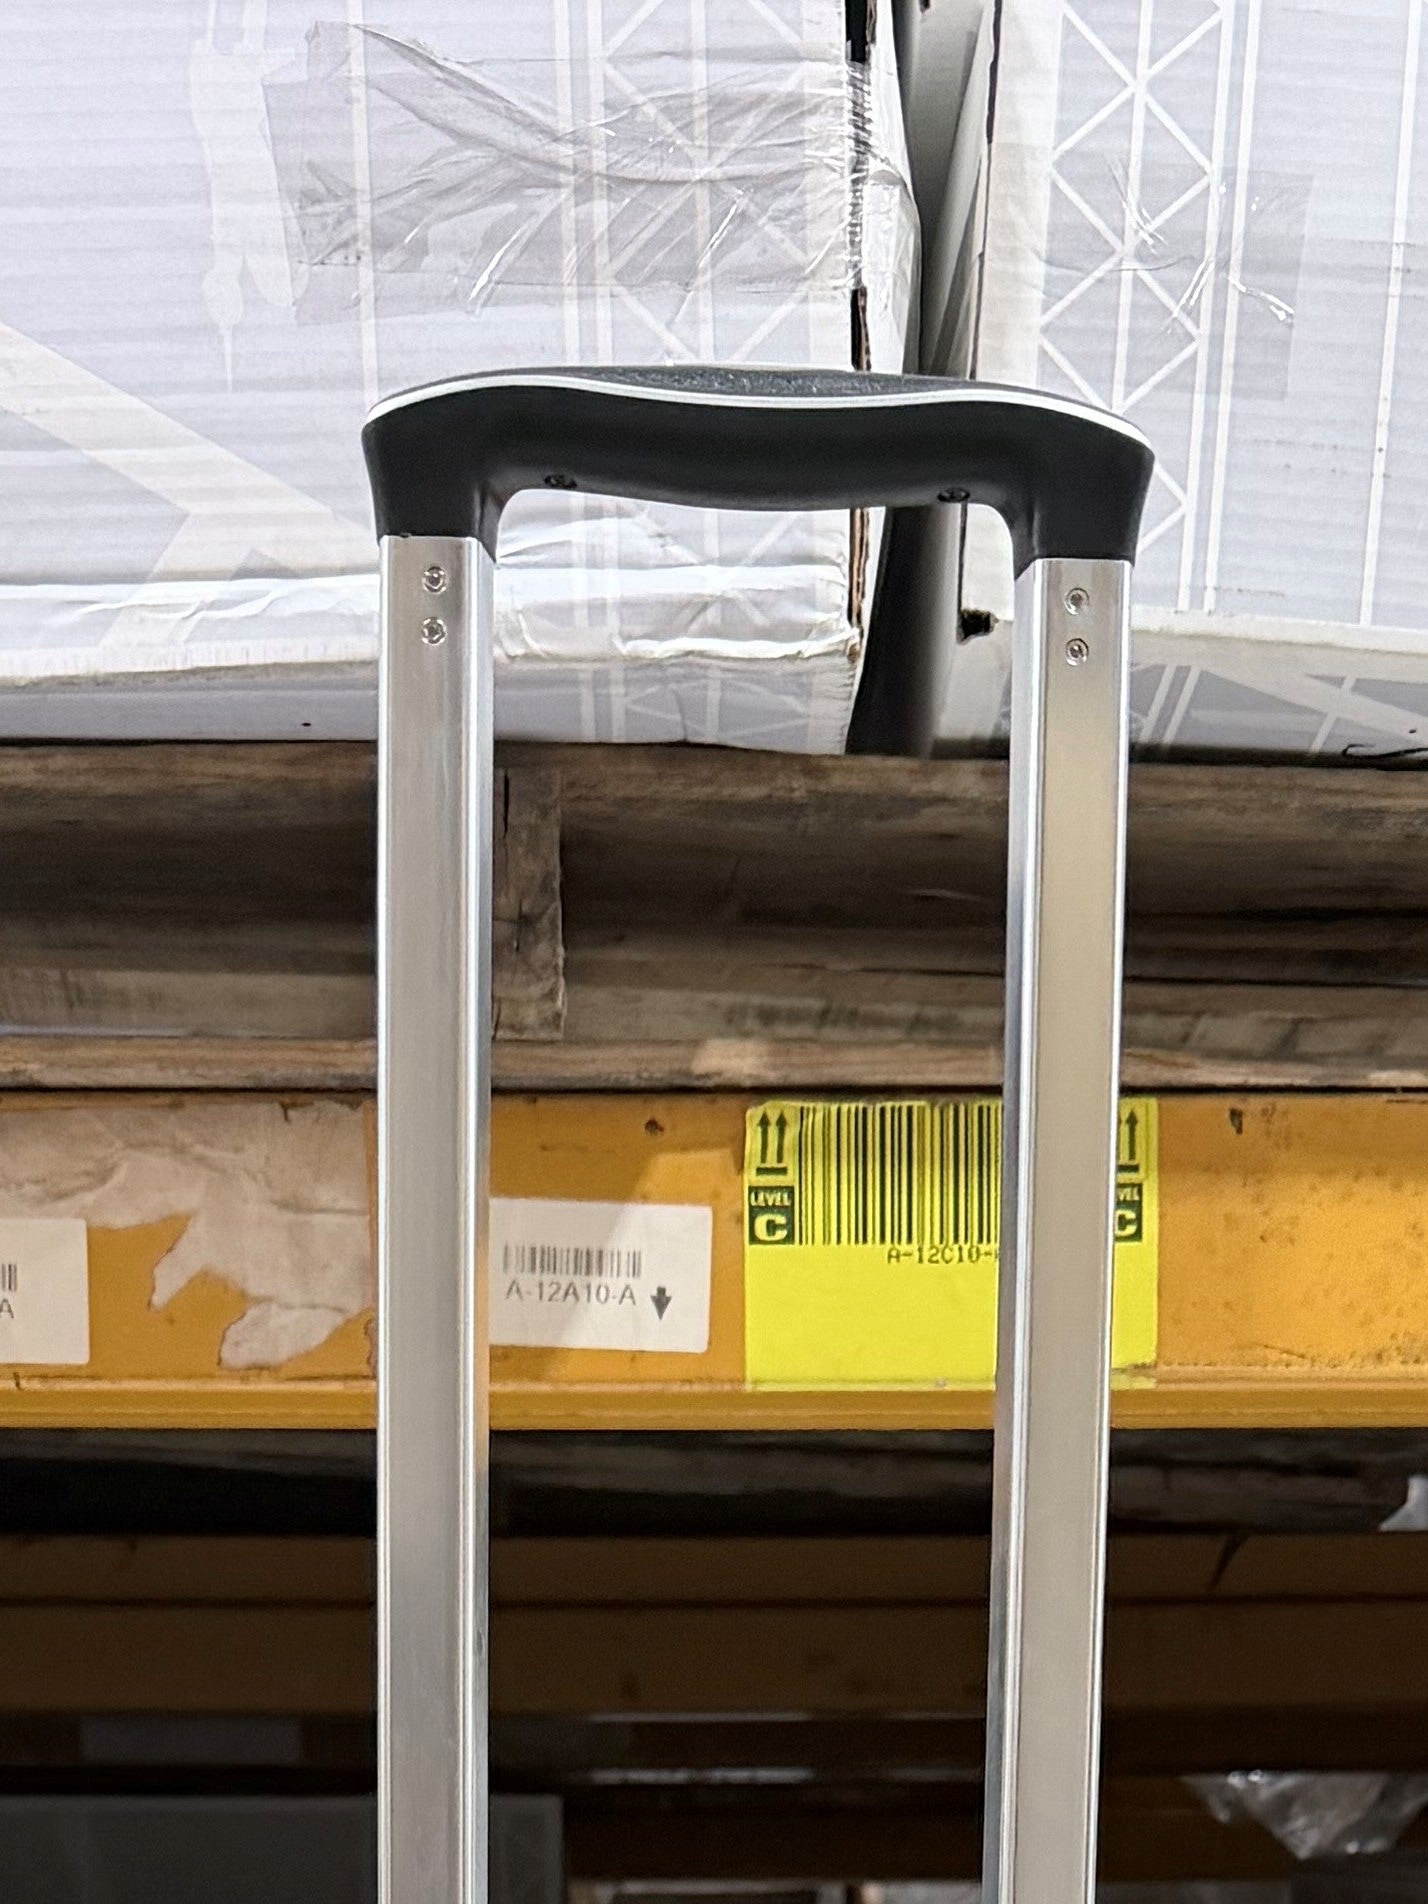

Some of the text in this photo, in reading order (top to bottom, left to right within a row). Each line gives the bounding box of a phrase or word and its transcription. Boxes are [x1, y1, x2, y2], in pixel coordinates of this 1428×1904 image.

[750, 1190, 792, 1207] LEVEL
[753, 1213, 788, 1242] C
[1114, 1209, 1138, 1237] C
[887, 1244, 999, 1264] A-12C10-
[505, 1280, 637, 1306] A-12A10-A
